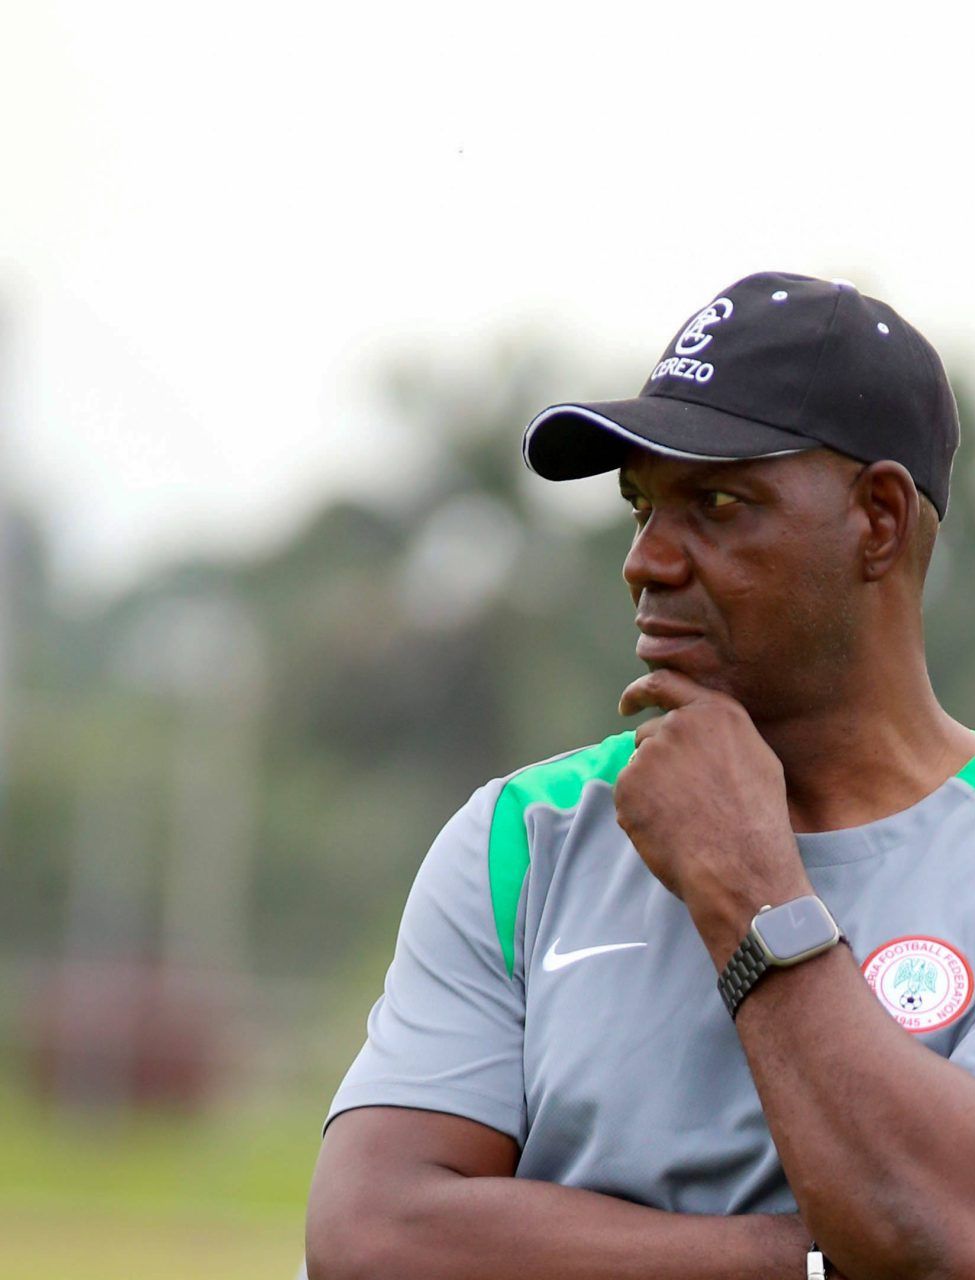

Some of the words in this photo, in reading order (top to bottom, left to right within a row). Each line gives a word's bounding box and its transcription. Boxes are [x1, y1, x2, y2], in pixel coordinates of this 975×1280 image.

[651, 357, 714, 382] CEREZO
[880, 942, 942, 963] FOOTBALL
[937, 954, 965, 1019] FEDERATION
